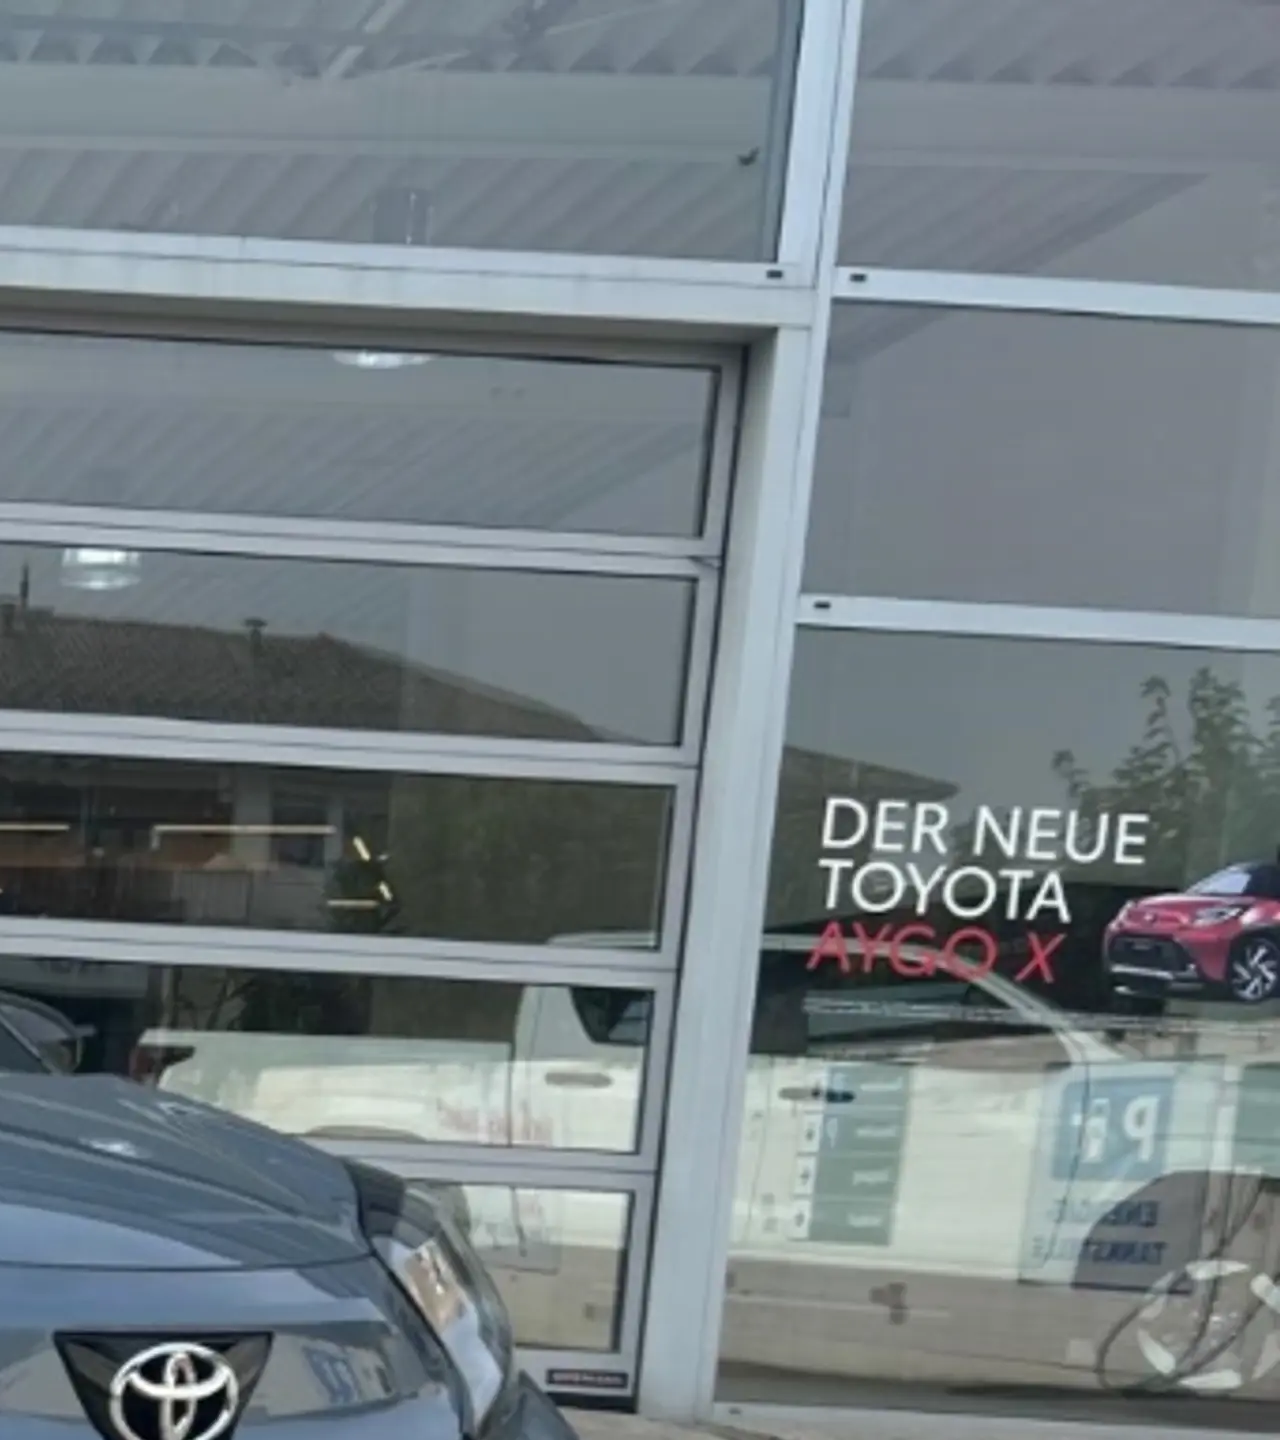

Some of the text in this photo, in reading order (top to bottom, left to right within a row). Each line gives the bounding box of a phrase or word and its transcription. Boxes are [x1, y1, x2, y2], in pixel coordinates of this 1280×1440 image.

[821, 796, 1150, 866] DER NEUE
[817, 858, 1072, 925] TOYOTA
[806, 919, 1067, 985] AYGO X
